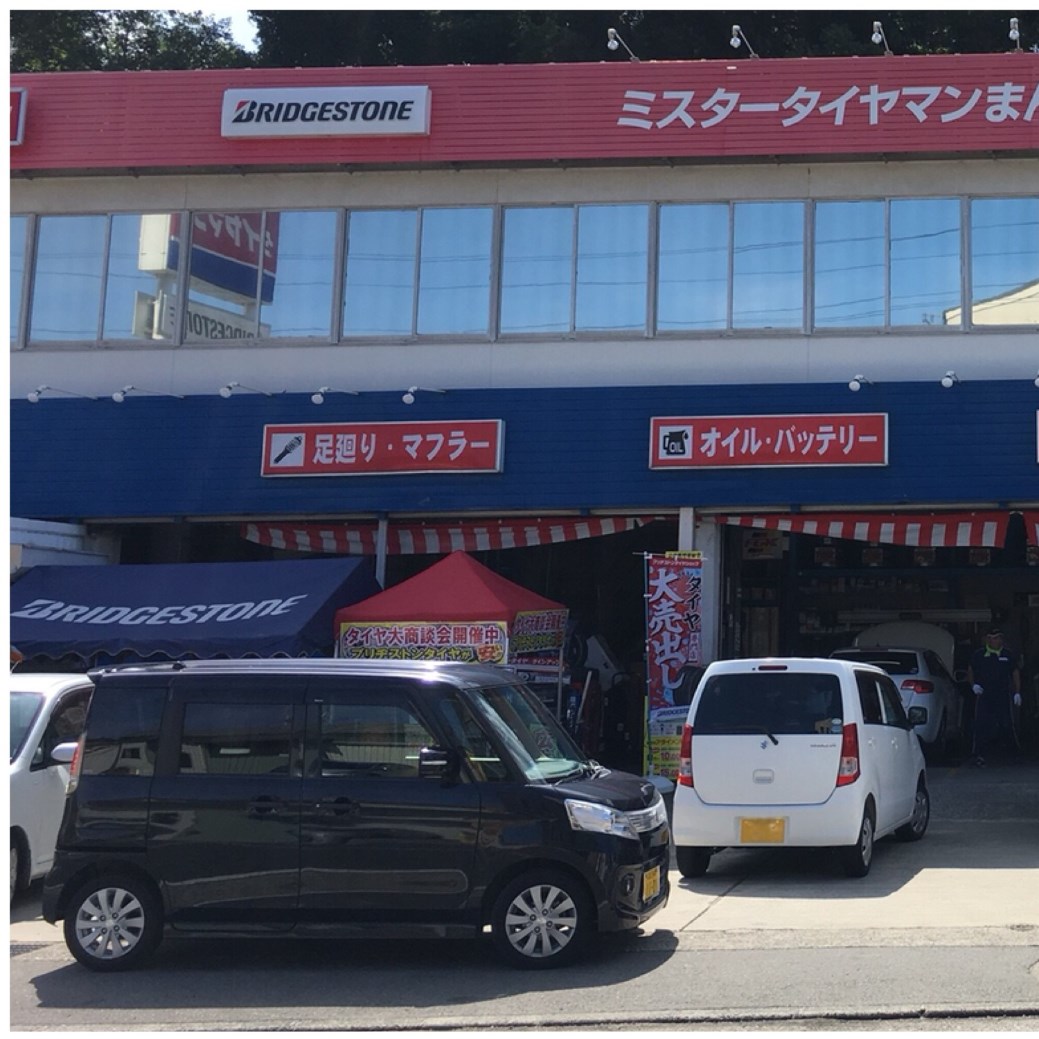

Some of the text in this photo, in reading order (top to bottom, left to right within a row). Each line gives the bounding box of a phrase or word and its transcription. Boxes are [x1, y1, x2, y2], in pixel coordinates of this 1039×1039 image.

[231, 99, 414, 124] BRIDGESTONE
[313, 432, 490, 463] 足廻り・マフラー
[700, 423, 878, 458] オイル・バッテリー
[11, 595, 307, 625] BRIDGESTONE
[683, 576, 701, 632] タイヤ
[345, 626, 500, 646] タイヤ大商談会開催中
[649, 568, 686, 690] 大売出し
